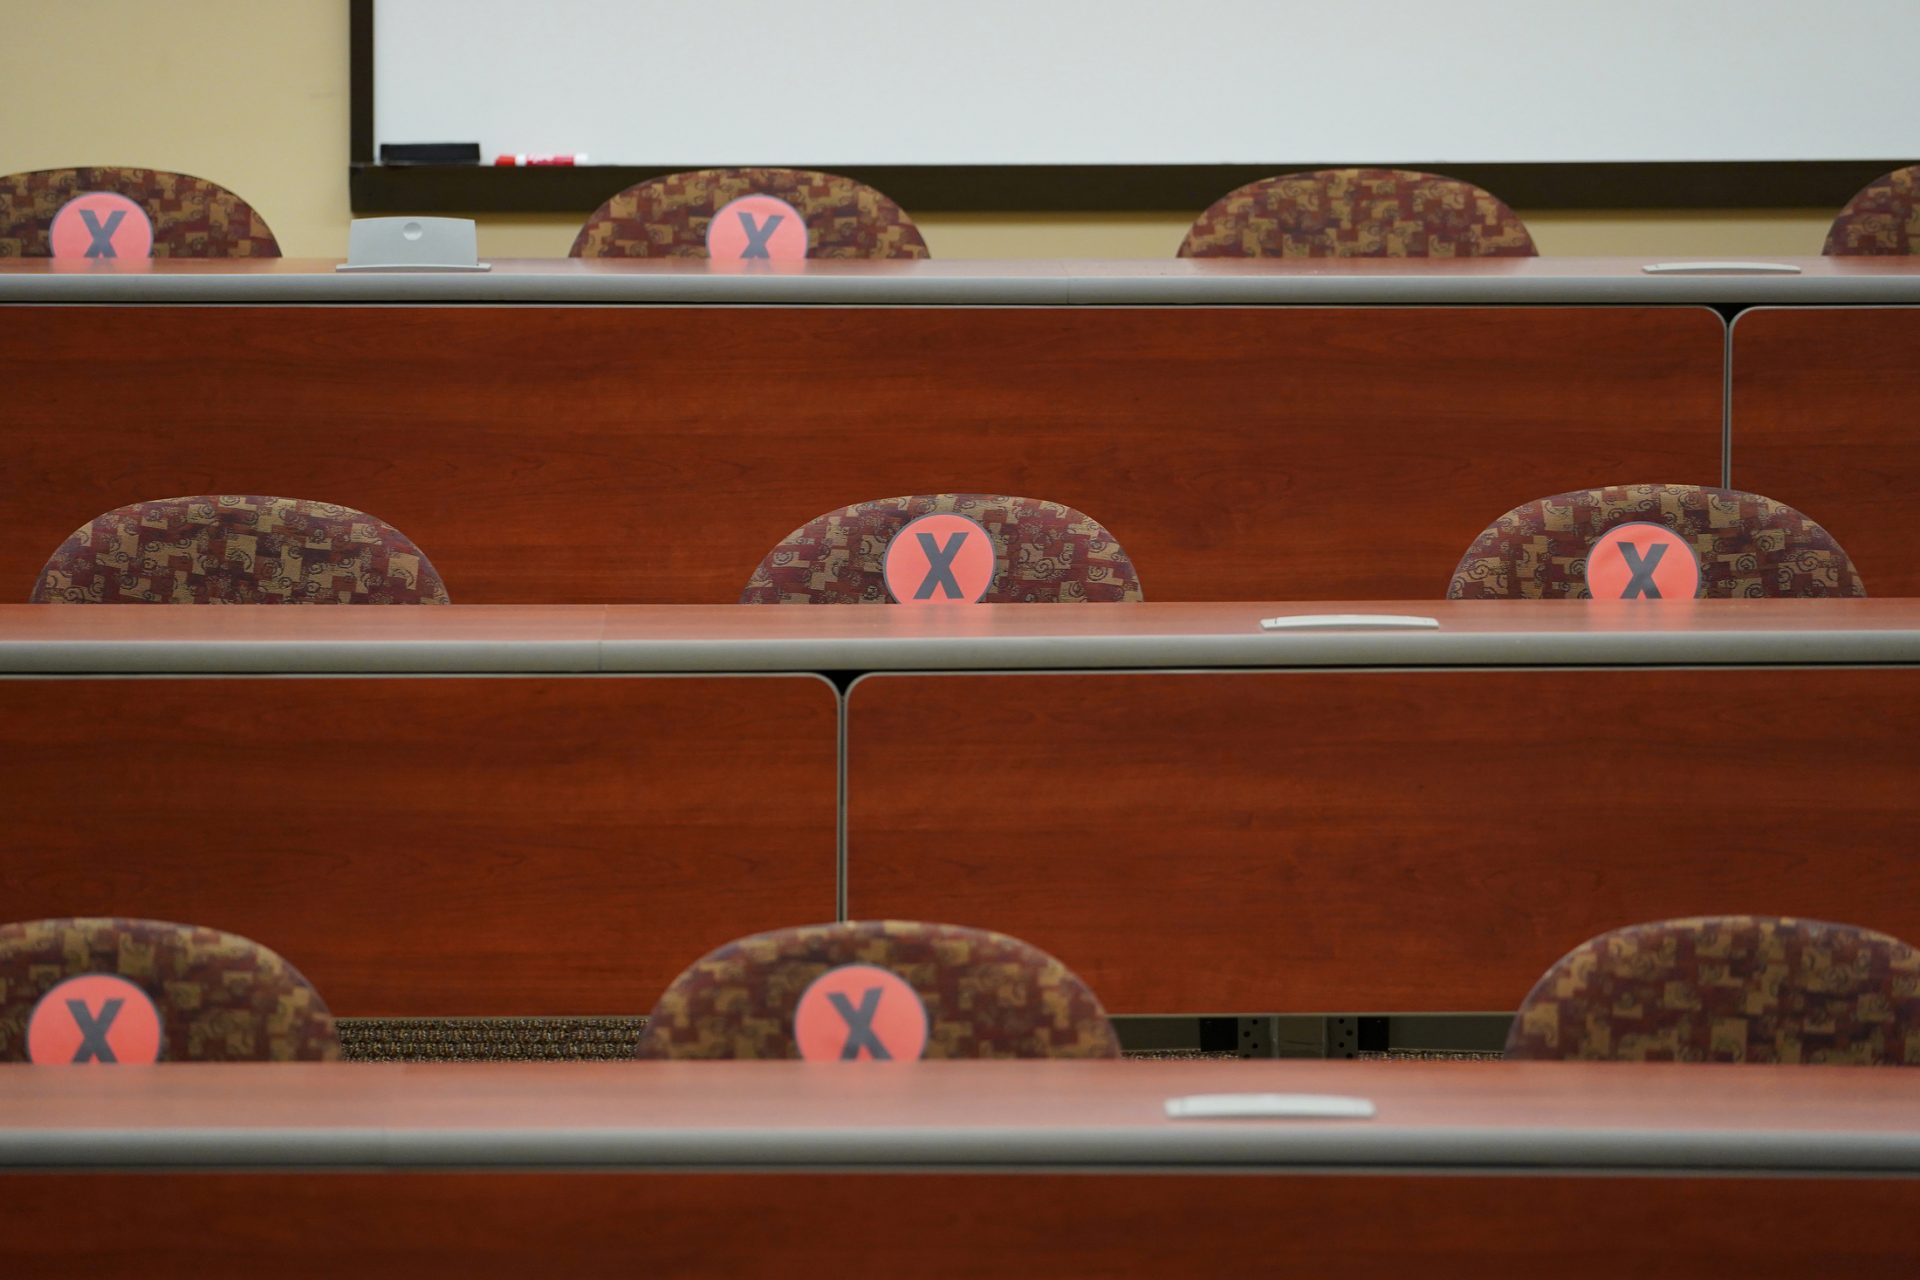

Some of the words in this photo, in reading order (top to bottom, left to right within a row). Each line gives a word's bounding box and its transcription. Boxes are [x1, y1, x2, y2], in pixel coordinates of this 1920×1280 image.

[78, 209, 126, 257] X
[737, 212, 784, 258] X
[913, 531, 969, 600] X
[1617, 541, 1670, 599] X
[65, 998, 125, 1064] X
[827, 987, 892, 1061] X
